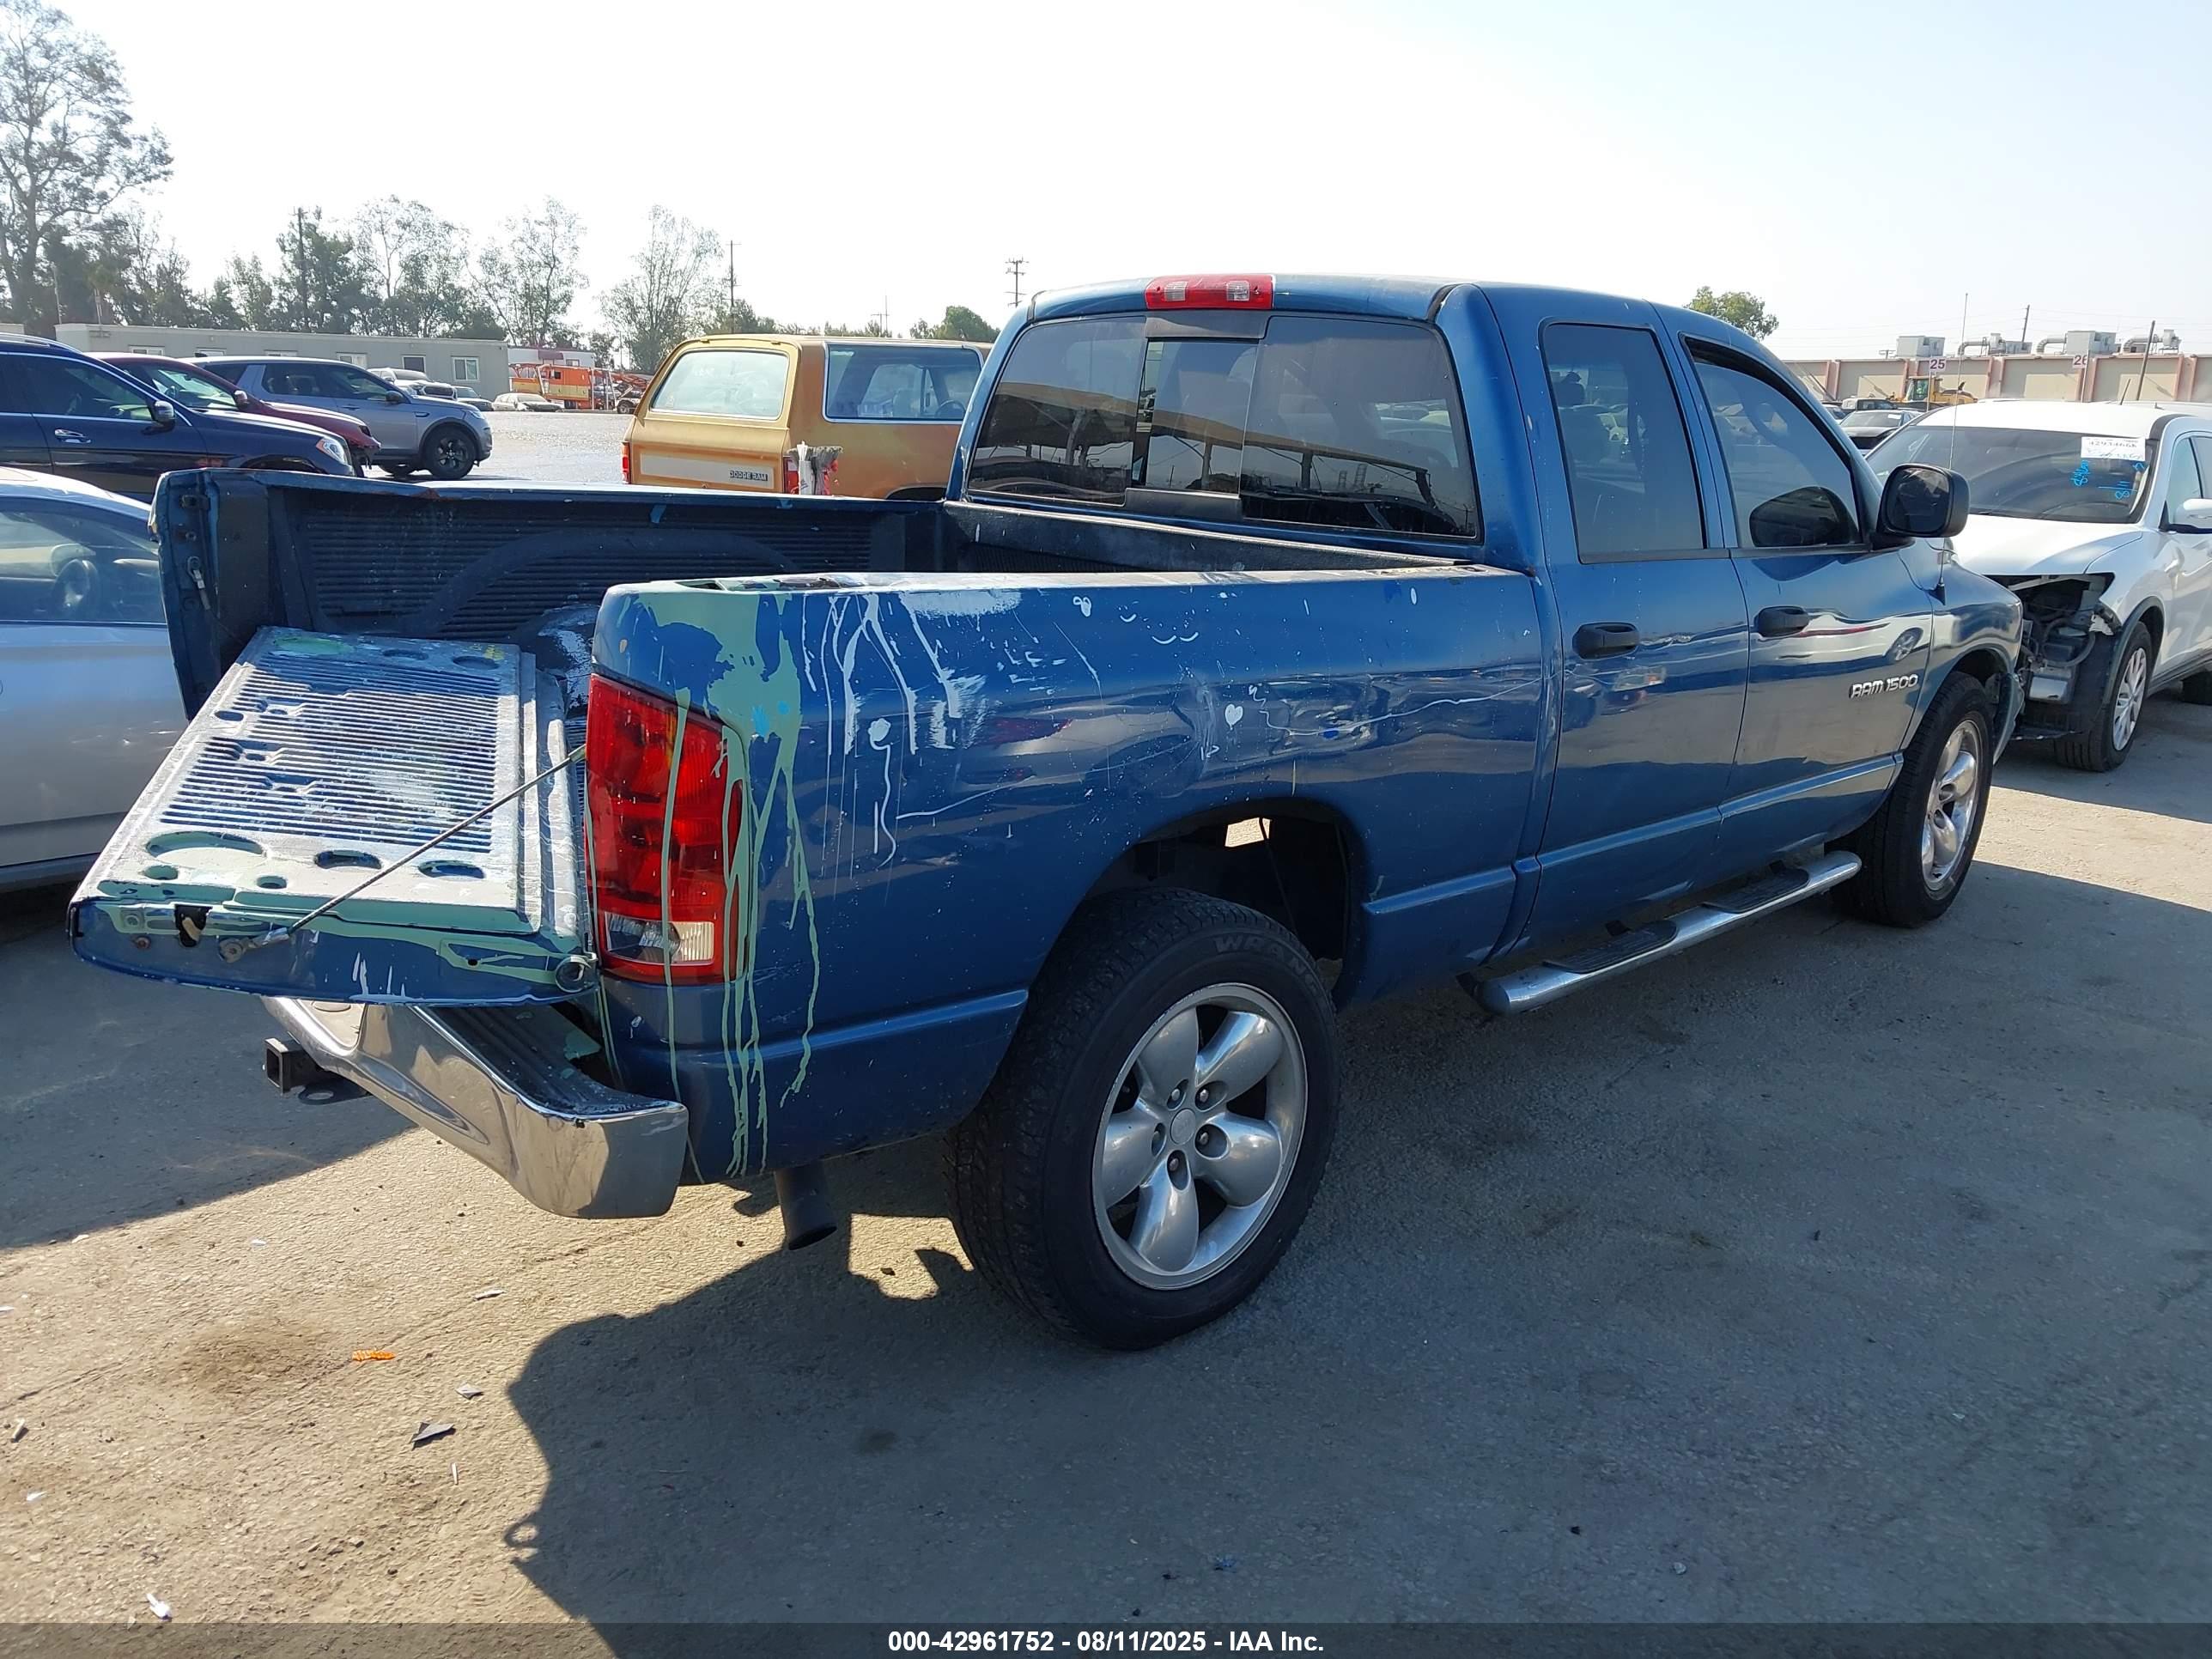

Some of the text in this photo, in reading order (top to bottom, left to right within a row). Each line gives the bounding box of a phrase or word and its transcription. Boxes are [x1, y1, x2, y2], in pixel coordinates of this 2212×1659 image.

[1929, 358, 1946, 369] 25
[1850, 673, 1919, 699] RAM 1500
